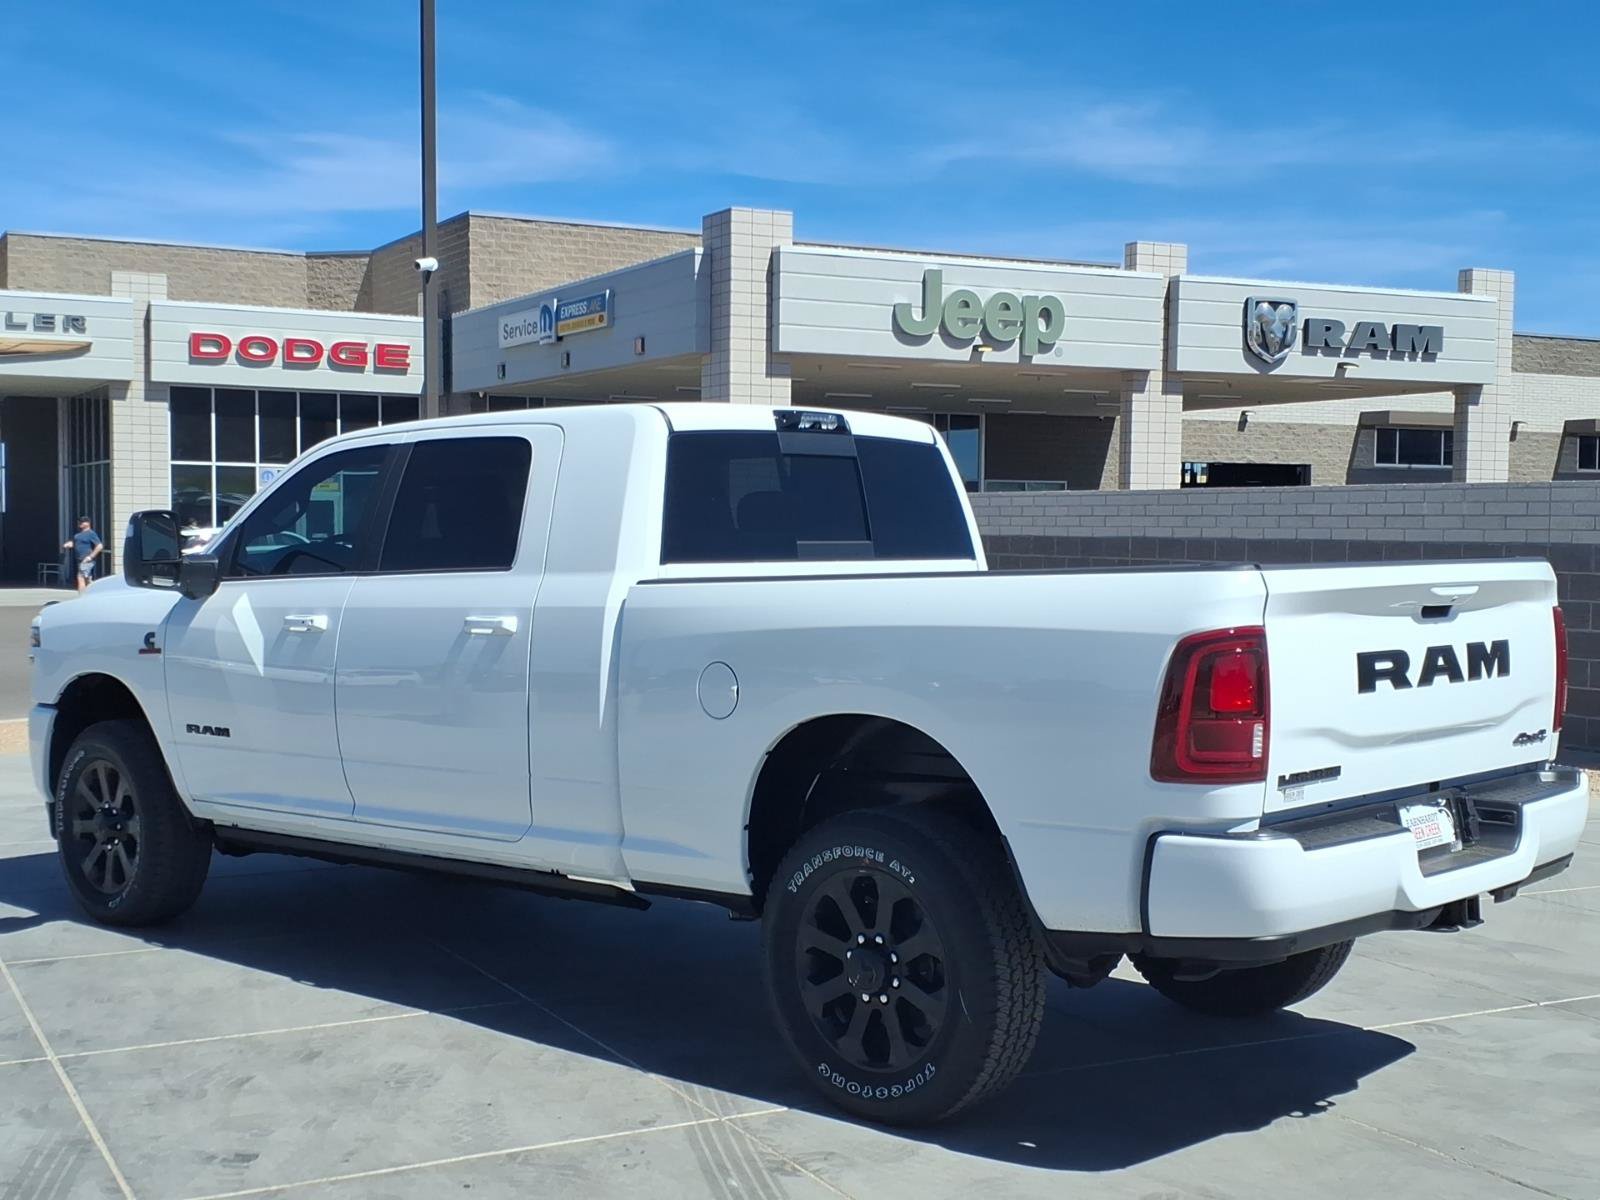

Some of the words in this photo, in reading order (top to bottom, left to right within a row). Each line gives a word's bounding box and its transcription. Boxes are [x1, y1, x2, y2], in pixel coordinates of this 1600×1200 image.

[560, 301, 588, 319] EXPRESS
[892, 269, 1065, 356] Jeep
[503, 318, 538, 340] Service
[1302, 318, 1444, 352] RAM
[190, 333, 410, 368] DODGE
[1356, 639, 1510, 694] RAM
[186, 724, 231, 738] RAM
[787, 846, 885, 893] TRANSFORCE
